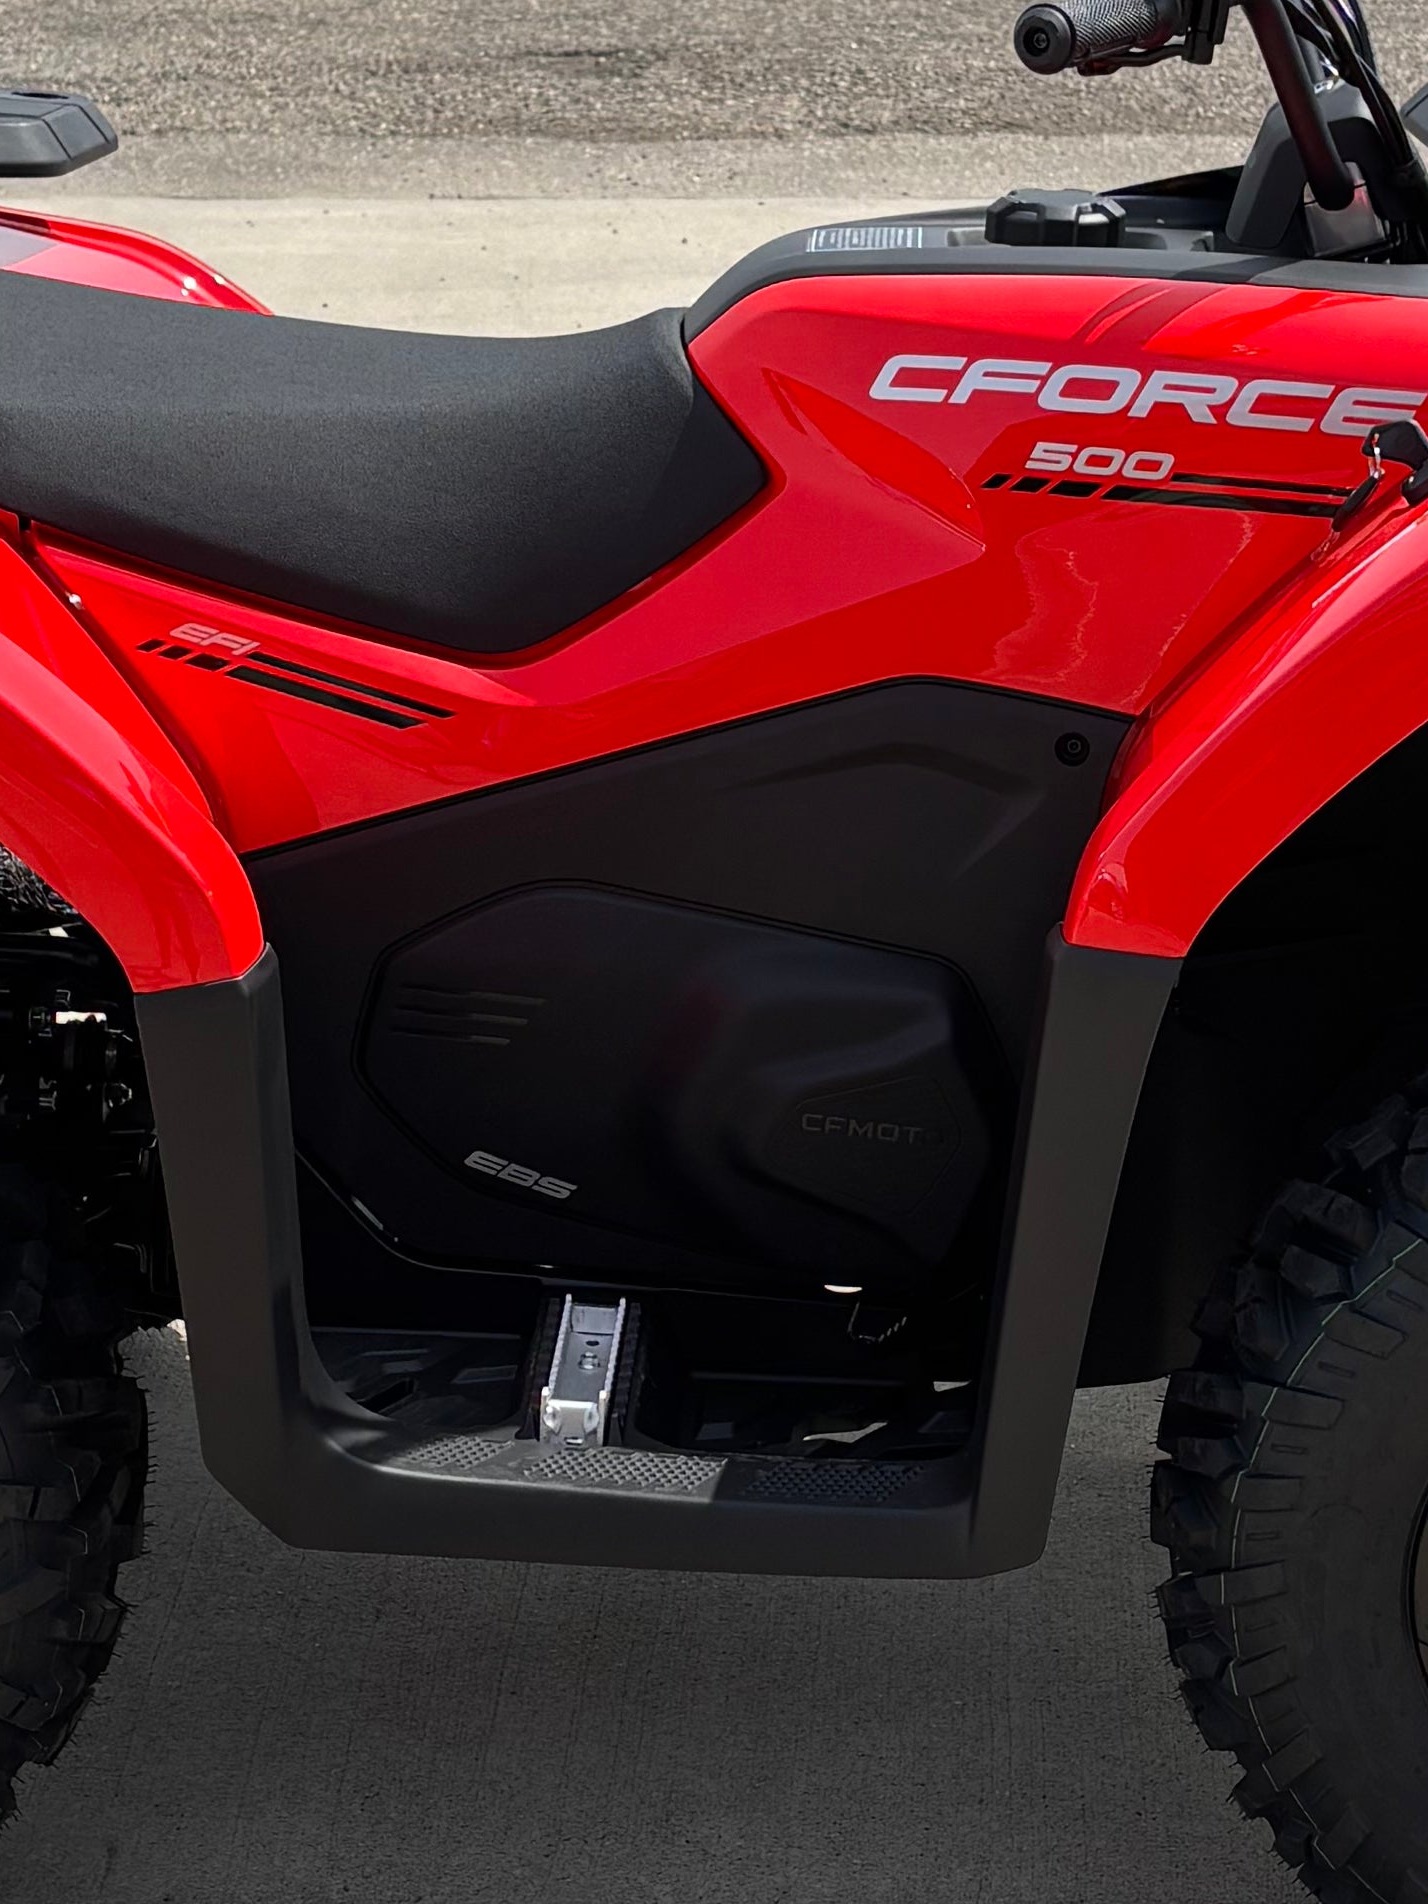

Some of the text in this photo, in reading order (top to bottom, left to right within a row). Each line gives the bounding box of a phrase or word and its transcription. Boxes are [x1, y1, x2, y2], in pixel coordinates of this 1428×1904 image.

[869, 354, 1428, 437] CFORCE
[1024, 442, 1175, 480] 500
[169, 622, 261, 656] EFI
[801, 1112, 938, 1146] CFMOT
[463, 1150, 578, 1199] EBS
